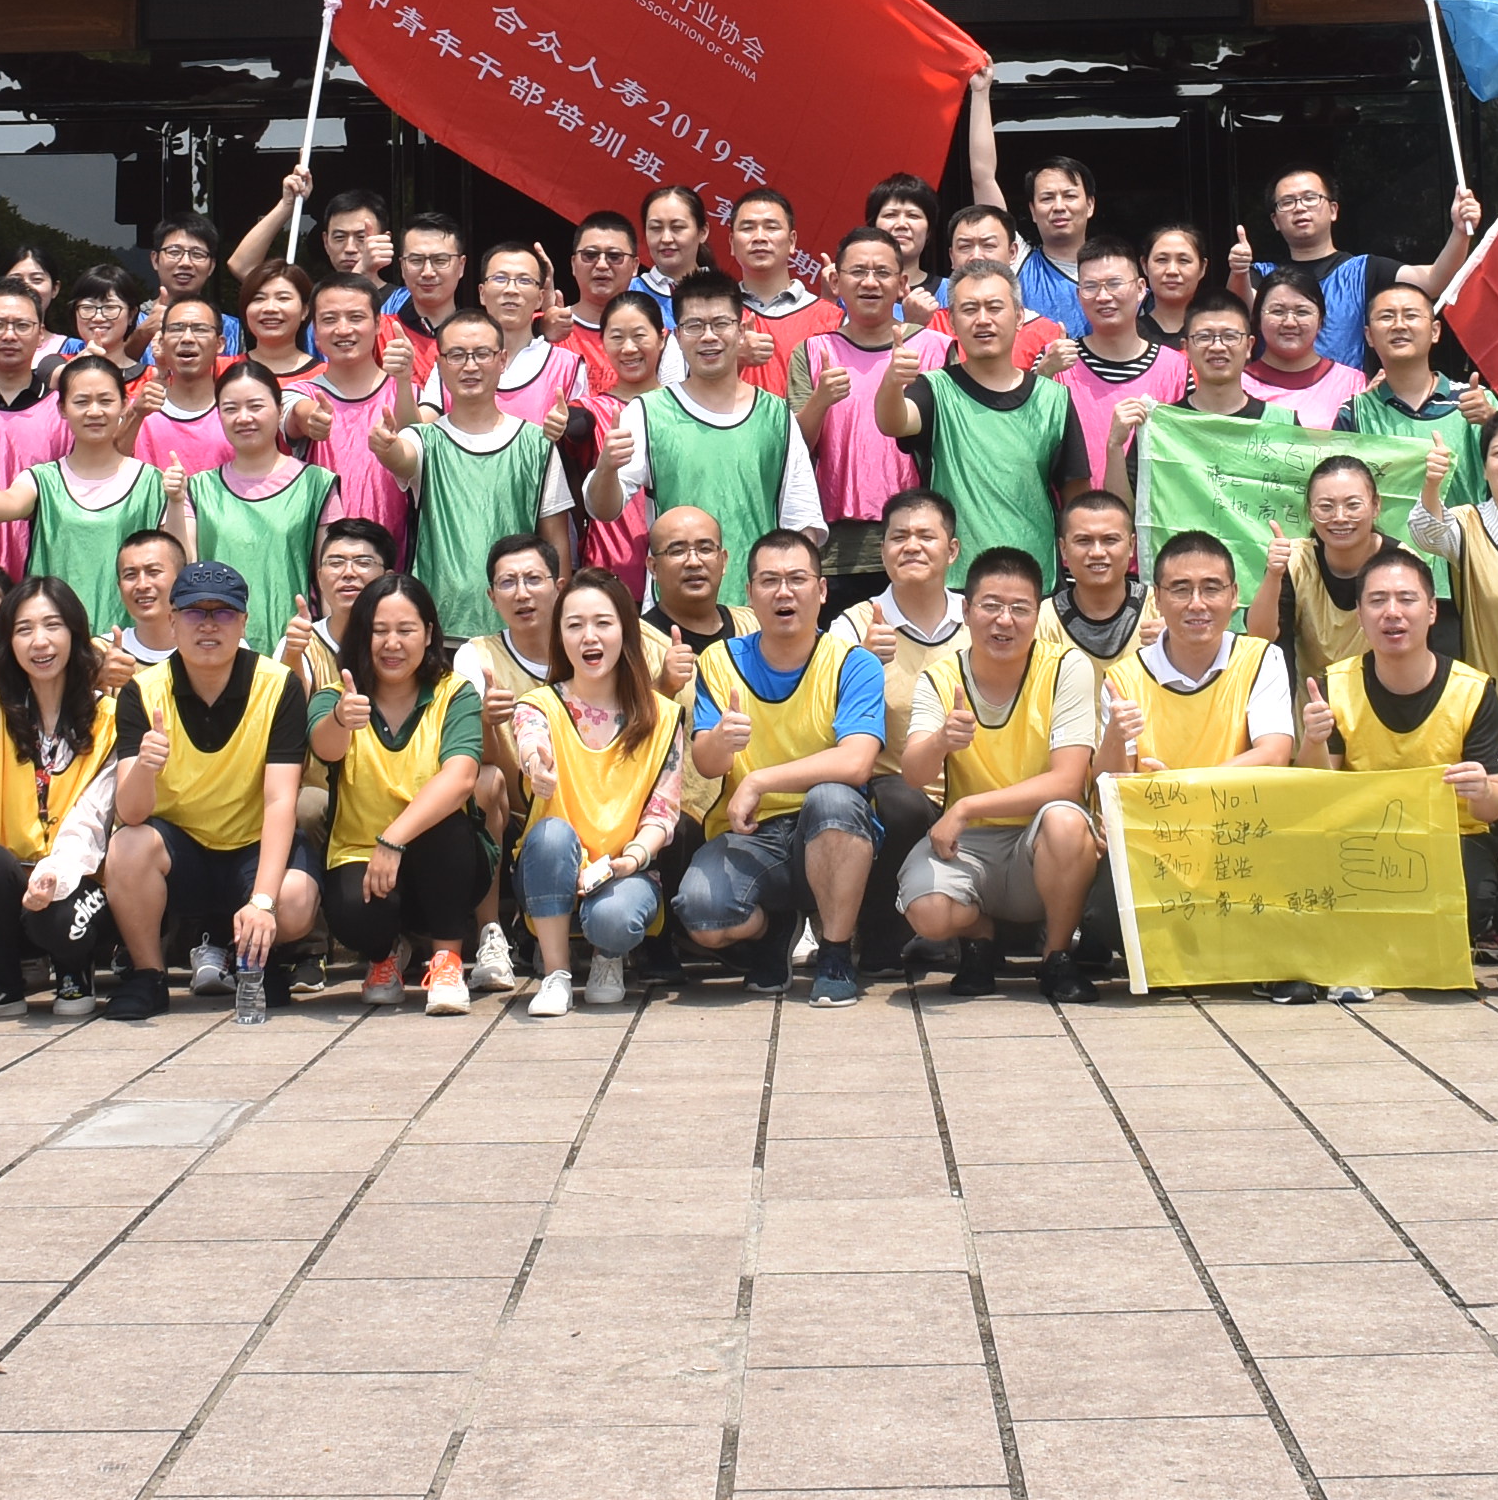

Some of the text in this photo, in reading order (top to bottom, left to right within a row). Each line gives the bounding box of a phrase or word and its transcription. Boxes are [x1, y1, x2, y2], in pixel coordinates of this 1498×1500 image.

[491, 3, 769, 187] 合众人寿2019年
[705, 41, 723, 56] OF
[723, 52, 758, 83] CHINA
